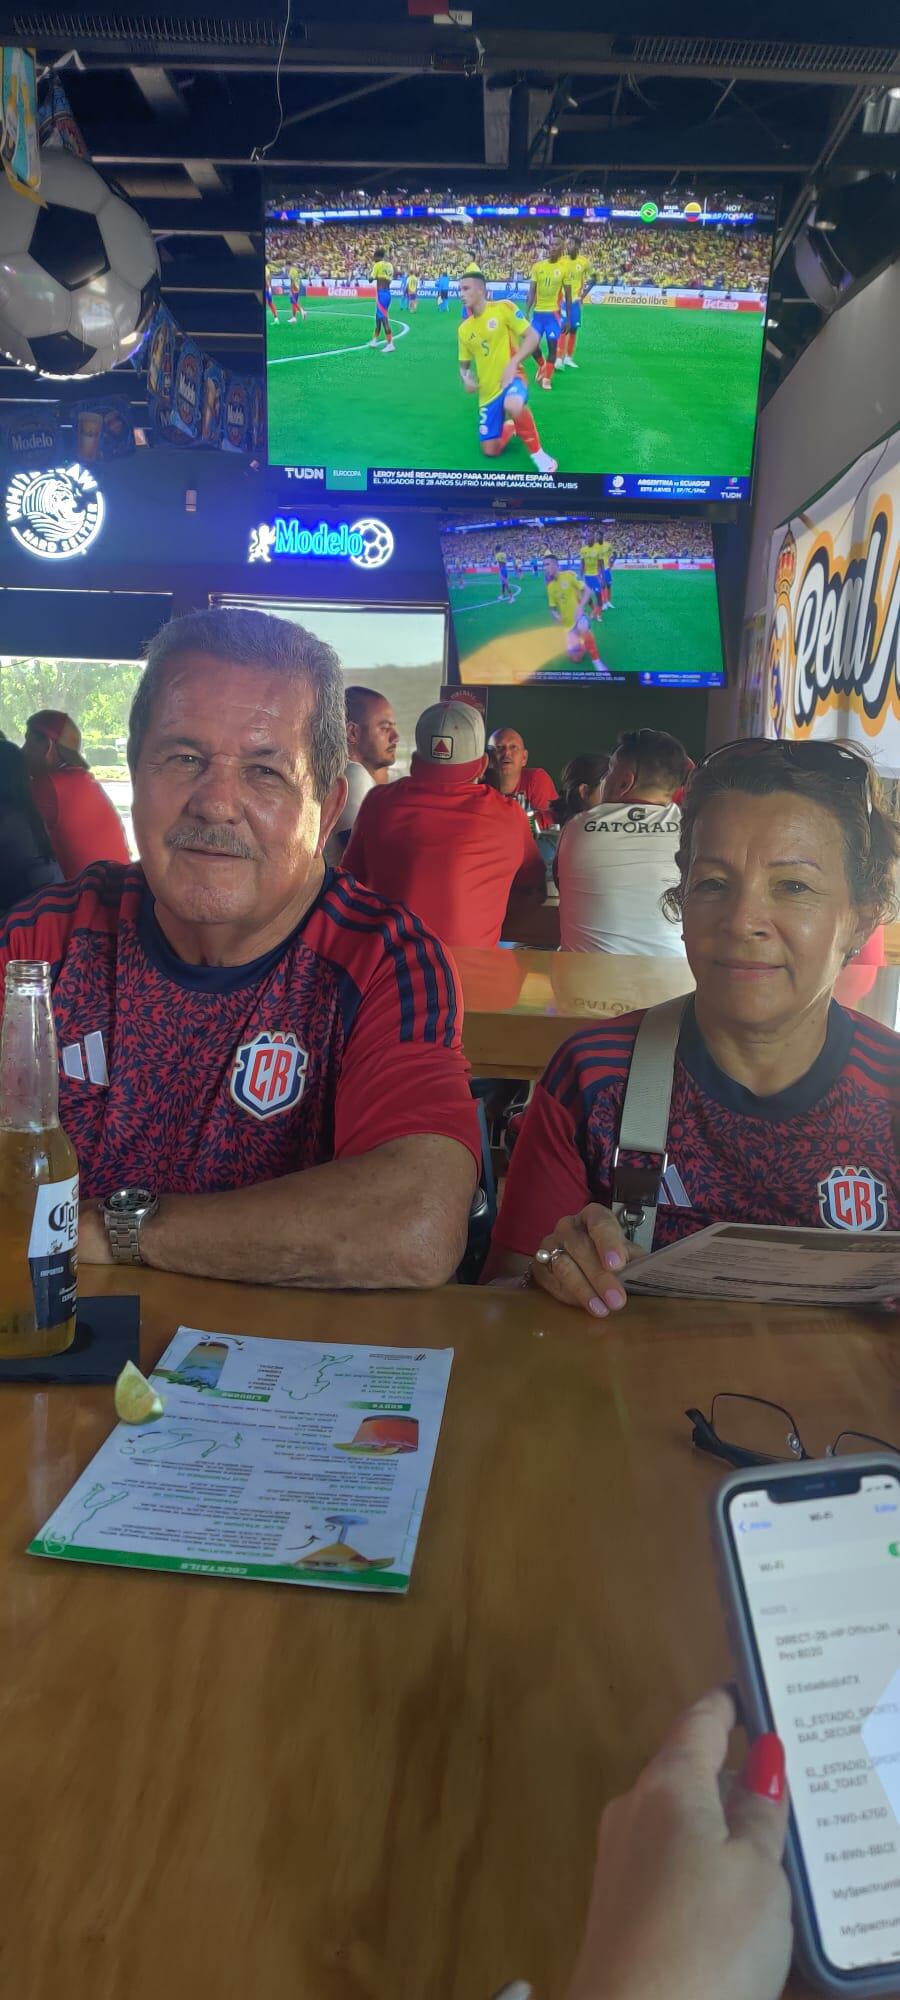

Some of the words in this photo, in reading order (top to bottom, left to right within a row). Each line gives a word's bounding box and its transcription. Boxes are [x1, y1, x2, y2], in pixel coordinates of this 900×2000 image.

[725, 204, 742, 212] HOY
[607, 295, 648, 304] mercado
[650, 295, 668, 305] libre
[11, 432, 53, 450] Modelo
[284, 467, 325, 479] TUDN
[373, 470, 396, 478] LEROY
[396, 469, 415, 479] SANÉ
[415, 471, 463, 480] RECUPERADO
[463, 472, 483, 480] PARA
[483, 473, 506, 481] JUGAR
[506, 473, 525, 481] ANTE
[525, 473, 554, 482] ESPAÑA
[382, 478, 415, 486] JUGADOR
[496, 480, 542, 489] INFLAMACIÓN
[543, 481, 557, 489] DEL
[22, 529, 57, 552] HARD
[274, 517, 364, 556] Modelo
[627, 807, 646, 821] G
[584, 821, 680, 834] GATORAD
[249, 1048, 293, 1103] CR
[834, 1181, 872, 1227] CR
[180, 1563, 248, 1575] COCKTAILS
